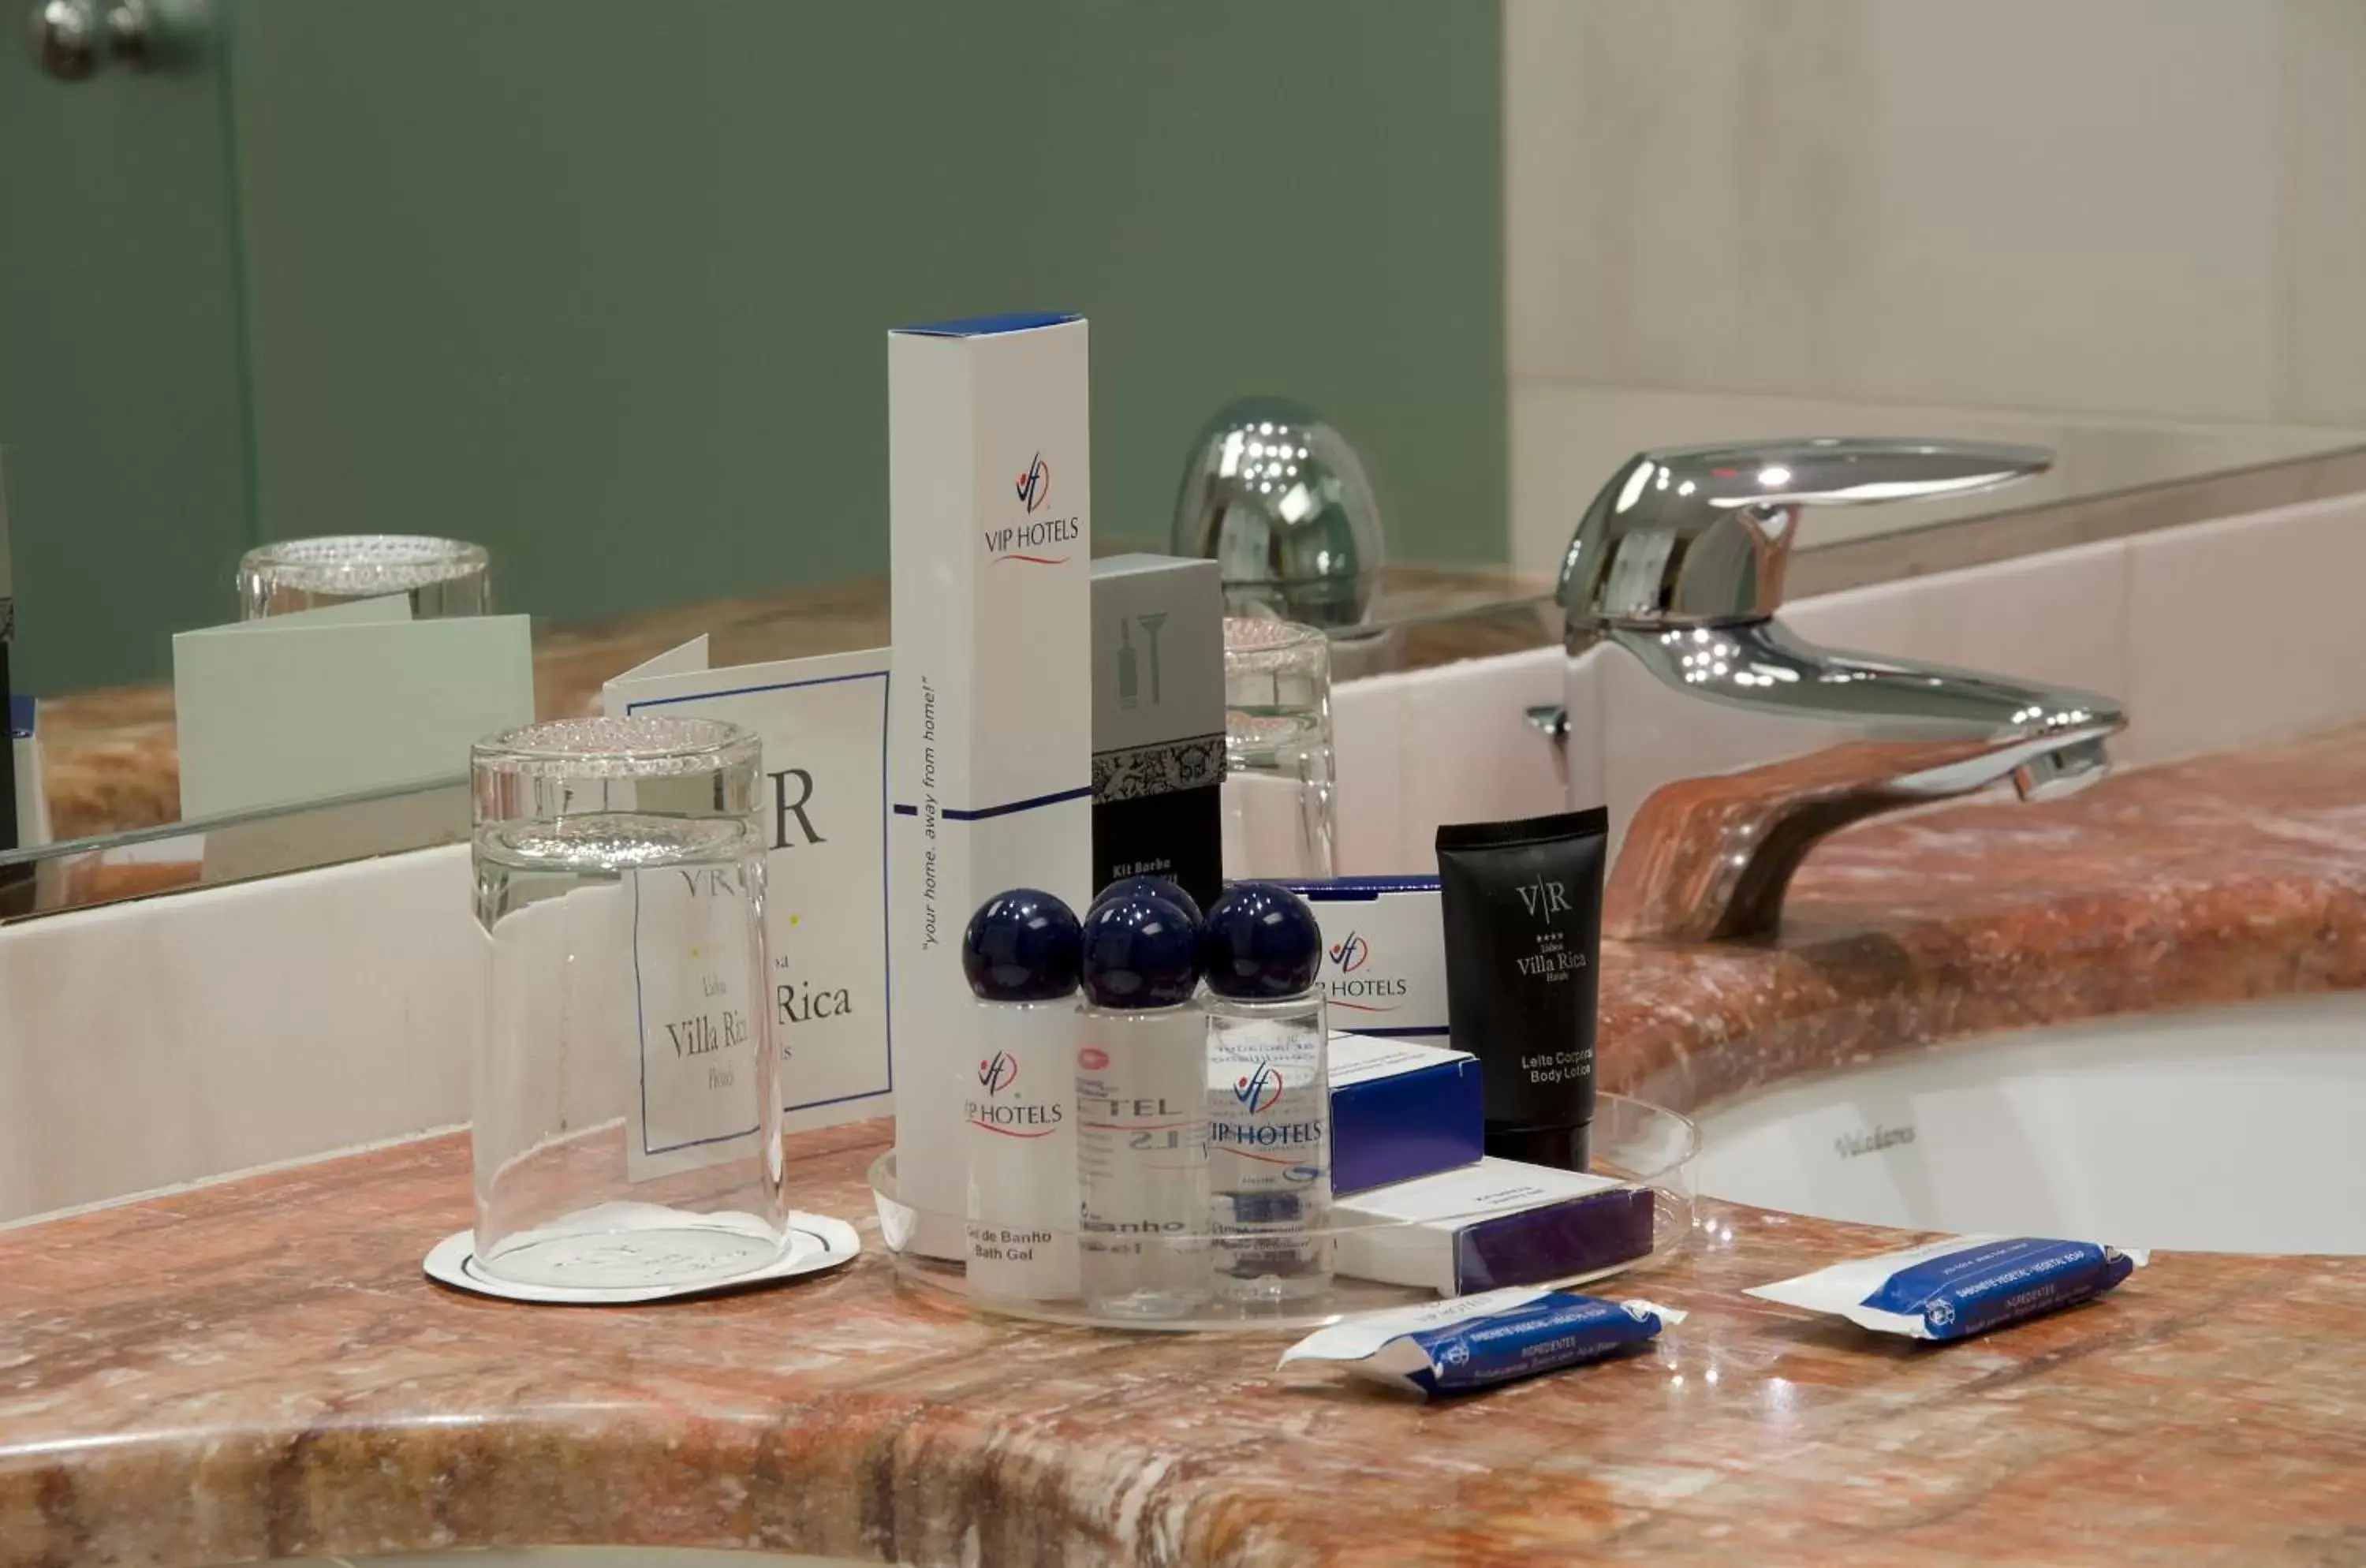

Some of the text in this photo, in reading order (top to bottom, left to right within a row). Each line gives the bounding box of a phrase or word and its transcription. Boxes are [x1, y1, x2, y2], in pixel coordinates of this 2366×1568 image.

[985, 517, 1078, 552] VIP HOTELS
[923, 747, 935, 787] from
[925, 794, 939, 839] away
[1517, 950, 1586, 976] Villa Rica
[1333, 979, 1406, 997] HOTELS
[777, 980, 853, 1025] Rica
[666, 1016, 719, 1059] Villa
[1531, 1069, 1562, 1084] Body
[981, 1103, 1062, 1124] HOTELS
[1237, 1121, 1323, 1145] HOTELS
[983, 1230, 997, 1242] de
[1001, 1230, 1052, 1244] Banho
